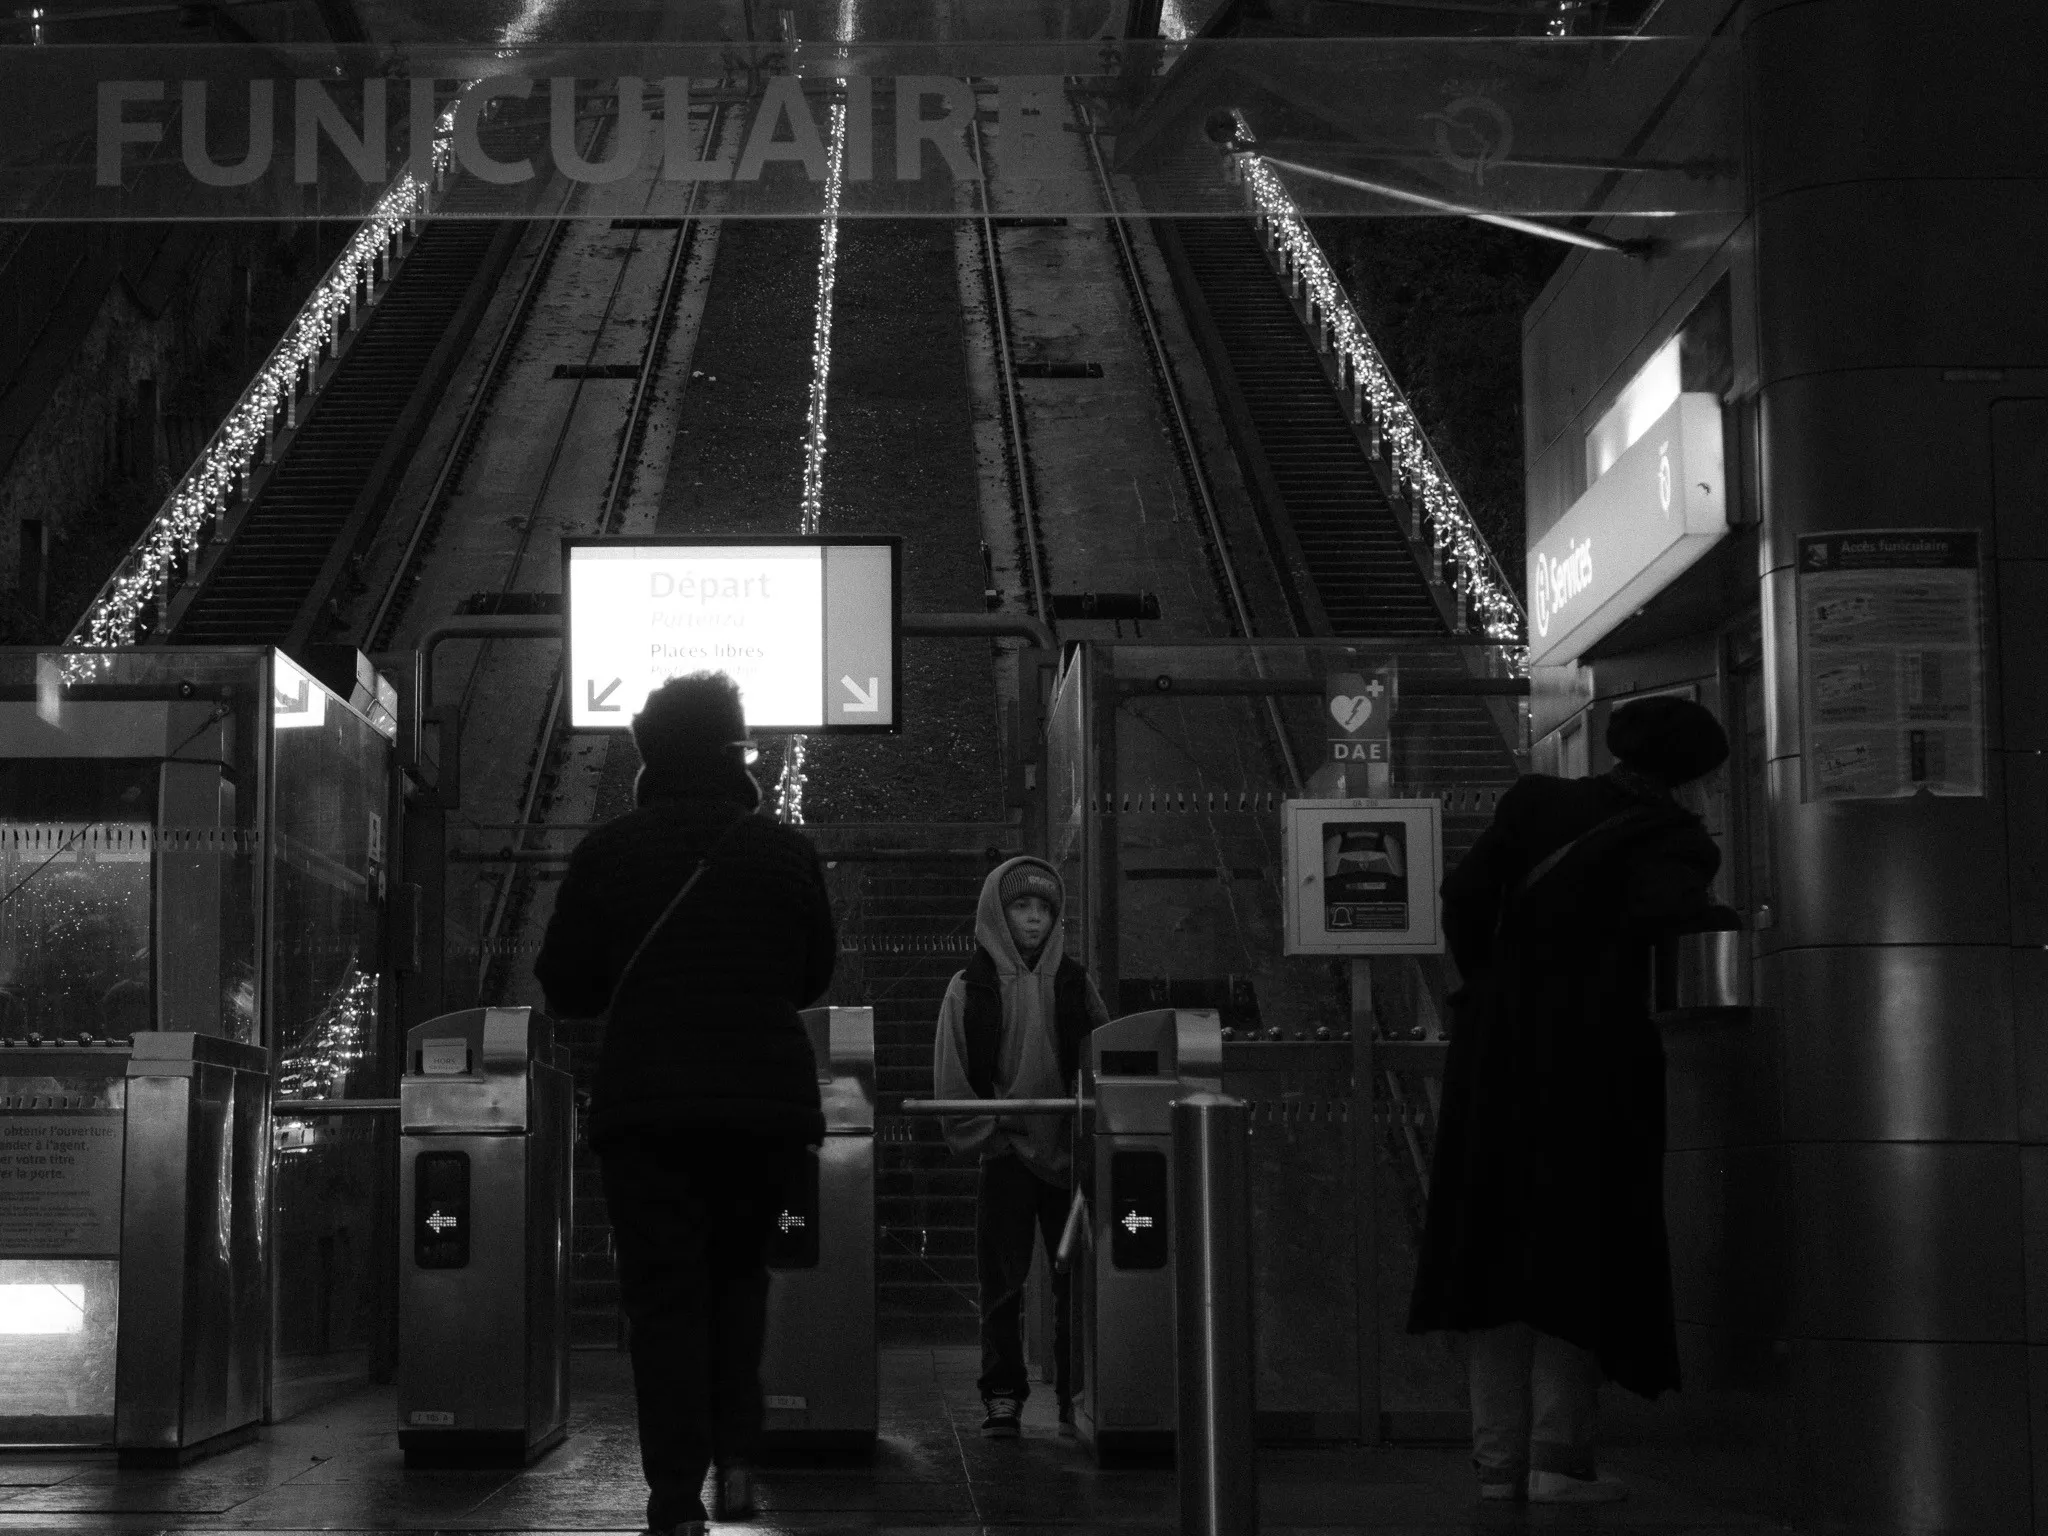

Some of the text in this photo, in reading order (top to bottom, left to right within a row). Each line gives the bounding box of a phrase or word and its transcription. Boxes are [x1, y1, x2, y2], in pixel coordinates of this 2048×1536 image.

[96, 74, 1064, 188] FUNICULAIRE
[1841, 538, 1949, 553] Accès funiculaire
[650, 570, 771, 606] Départ
[651, 610, 745, 629] Partenza
[650, 643, 765, 658] Places libres
[1334, 743, 1380, 760] DAE
[4, 1124, 46, 1137] obtenir
[36, 1140, 42, 1151] à
[16, 1155, 46, 1165] votre
[50, 1154, 75, 1165] titre
[17, 1167, 27, 1178] la
